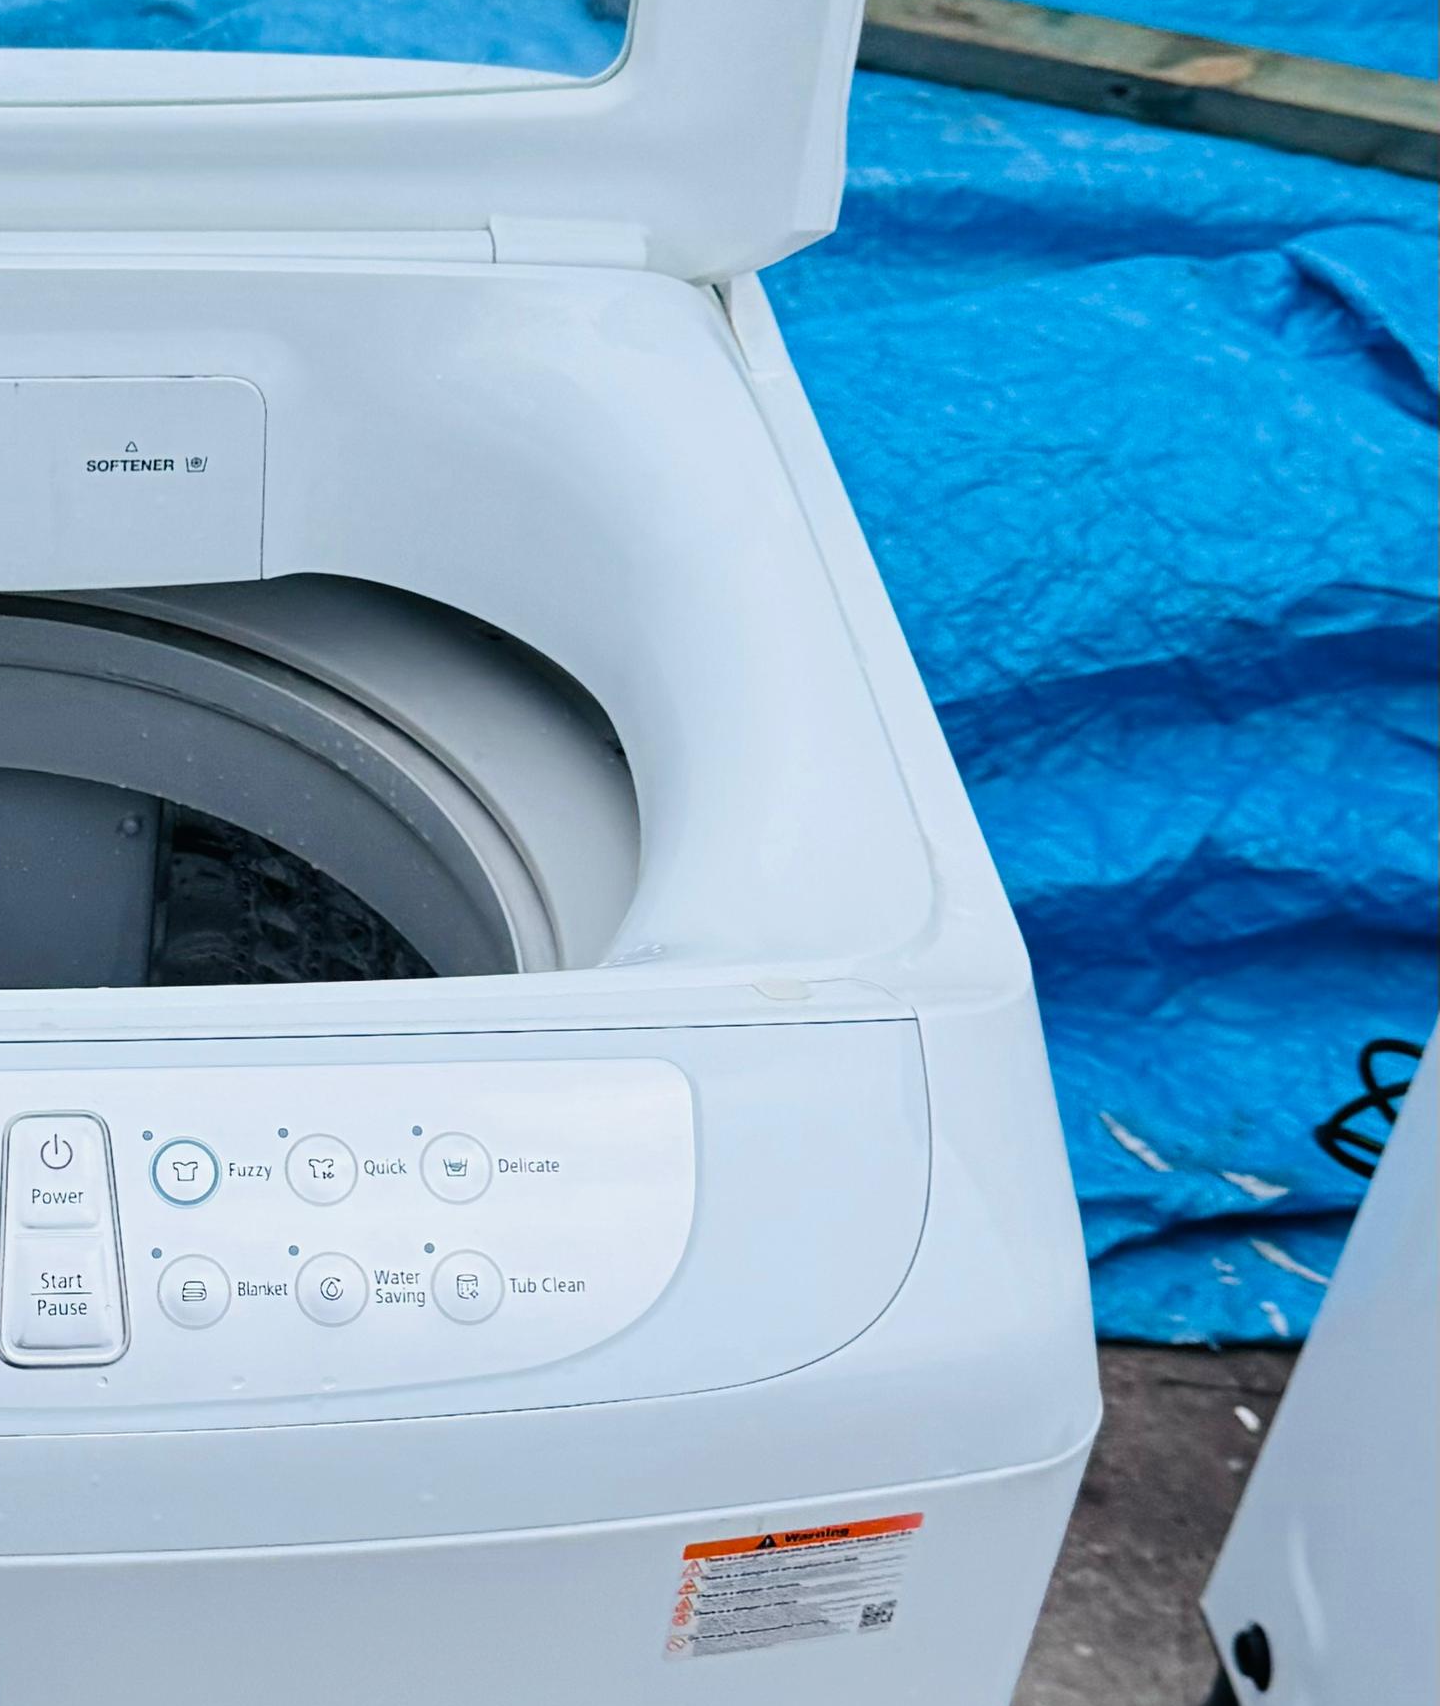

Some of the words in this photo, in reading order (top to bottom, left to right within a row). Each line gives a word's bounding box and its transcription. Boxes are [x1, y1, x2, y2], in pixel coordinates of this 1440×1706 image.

[86, 458, 175, 473] SOFTENER
[228, 1162, 272, 1181] Fuzzy
[363, 1158, 408, 1177] Quick
[498, 1158, 560, 1173] Delicate
[31, 1188, 84, 1205] Power
[40, 1272, 82, 1289] Start
[374, 1269, 420, 1285] Water
[509, 1277, 537, 1294] Tub
[541, 1276, 585, 1293] Clean
[237, 1281, 288, 1297] Blanket
[375, 1287, 426, 1308] Saving
[37, 1299, 88, 1317] Pause
[785, 1528, 849, 1543] Warning
